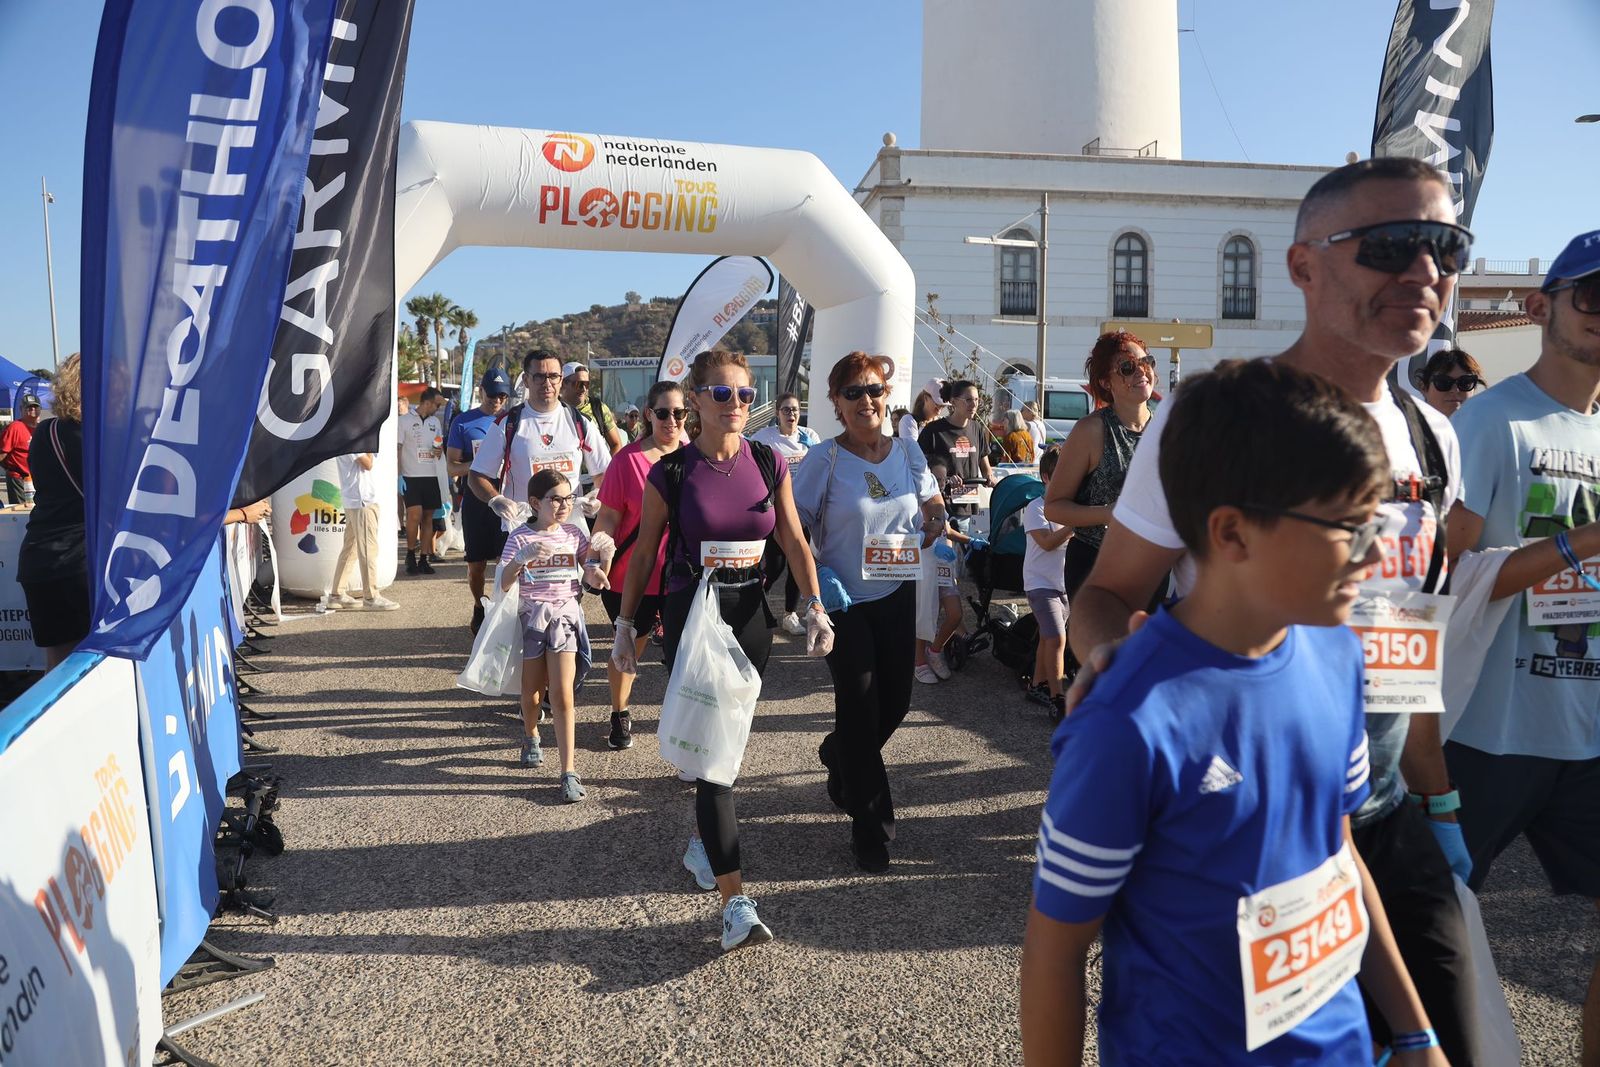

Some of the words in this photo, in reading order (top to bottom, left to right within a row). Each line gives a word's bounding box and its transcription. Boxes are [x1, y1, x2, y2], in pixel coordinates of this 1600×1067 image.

[604, 141, 686, 155] nationale
[606, 153, 718, 172] nederlanden
[674, 179, 718, 195] TOUR
[538, 185, 719, 233] PLOGGING
[624, 358, 653, 366] MÁLAGA
[314, 509, 346, 524] Ibiz
[871, 549, 915, 562] 25148
[1534, 657, 1555, 673] 15
[1263, 898, 1353, 984] 25149
